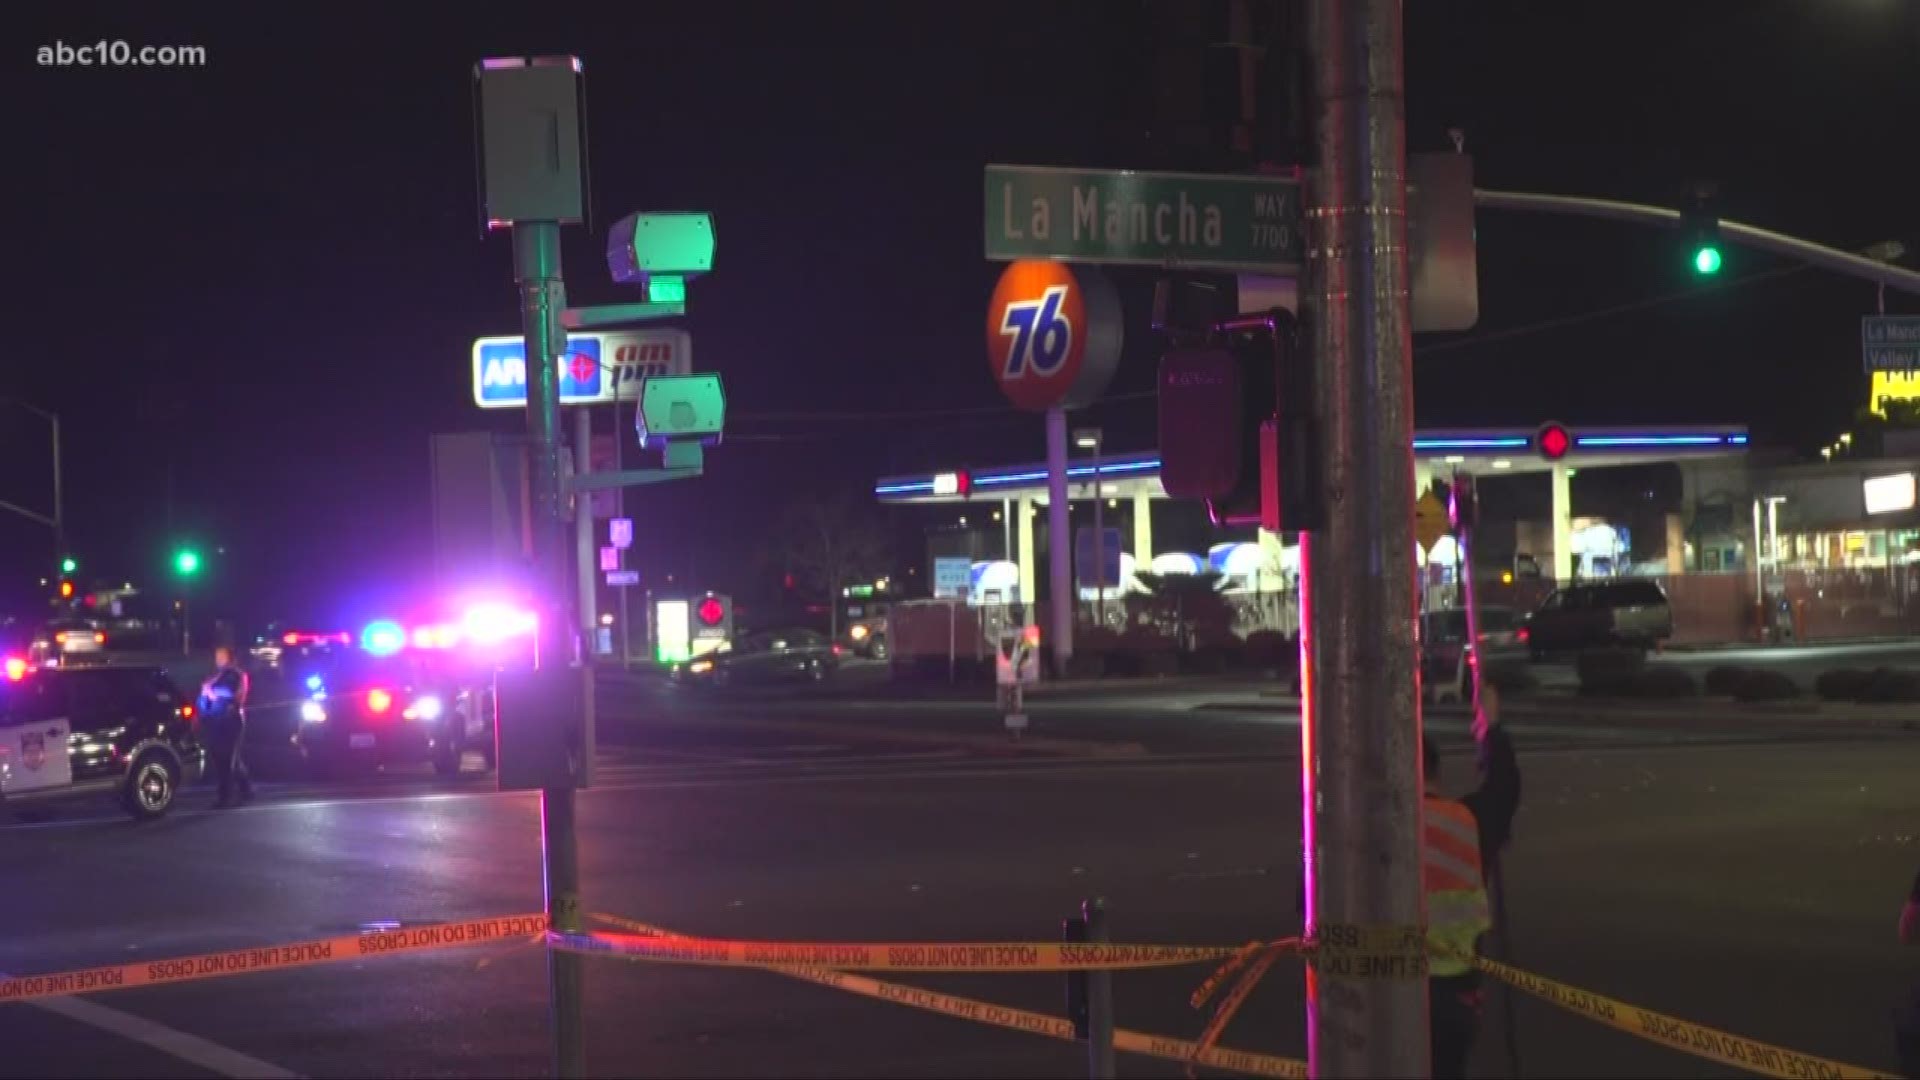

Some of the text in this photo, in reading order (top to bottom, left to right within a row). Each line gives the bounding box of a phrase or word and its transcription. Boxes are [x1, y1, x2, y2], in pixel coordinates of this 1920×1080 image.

[1004, 182, 1222, 247] La Mancha
[1254, 191, 1286, 217] WAY
[1252, 225, 1289, 248] 7700
[1000, 283, 1072, 379] 76
[615, 344, 672, 362] am
[1871, 350, 1914, 369] Valley
[412, 929, 440, 947] NOT
[443, 926, 464, 943] DO
[467, 922, 499, 938] LINE
[359, 934, 408, 955] CROSS
[149, 942, 331, 980] POLICE LINE DO NOT CROSS
[888, 946, 1038, 966] POLICE LINE DO NOT CROSS
[0, 968, 123, 998] POLICE LINE DO NO
